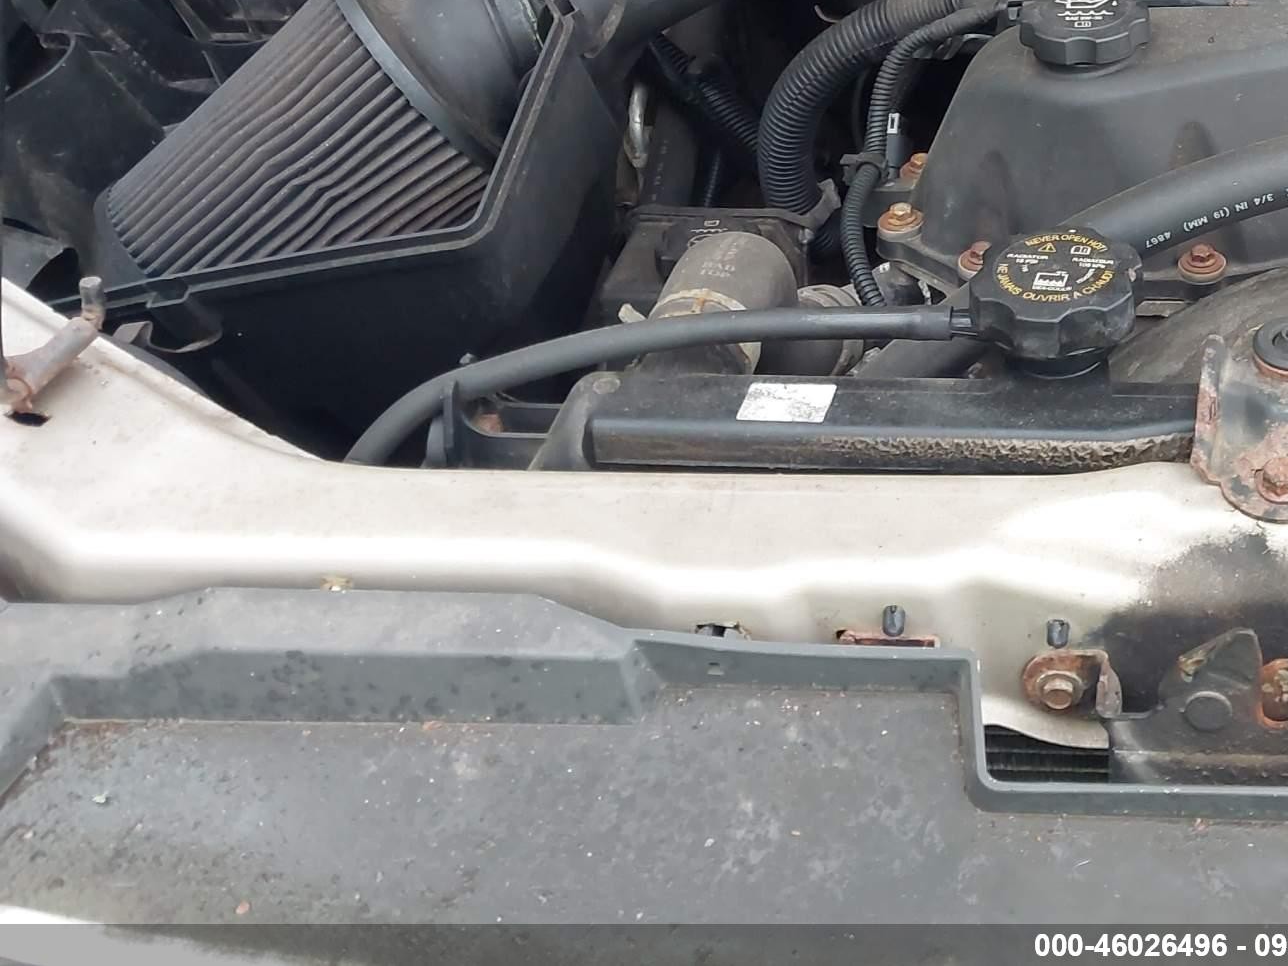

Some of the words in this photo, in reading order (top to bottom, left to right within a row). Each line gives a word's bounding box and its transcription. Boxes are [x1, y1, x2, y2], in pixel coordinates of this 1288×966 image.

[1253, 193, 1274, 206] 3/4
[1213, 206, 1230, 219] (19
[1235, 201, 1249, 213] IN
[1183, 216, 1209, 232] MM)
[1025, 234, 1060, 247] NEVER
[1061, 234, 1089, 245] OPEN
[1145, 231, 1172, 249] 4867
[1022, 292, 1071, 302] OUVRIR
